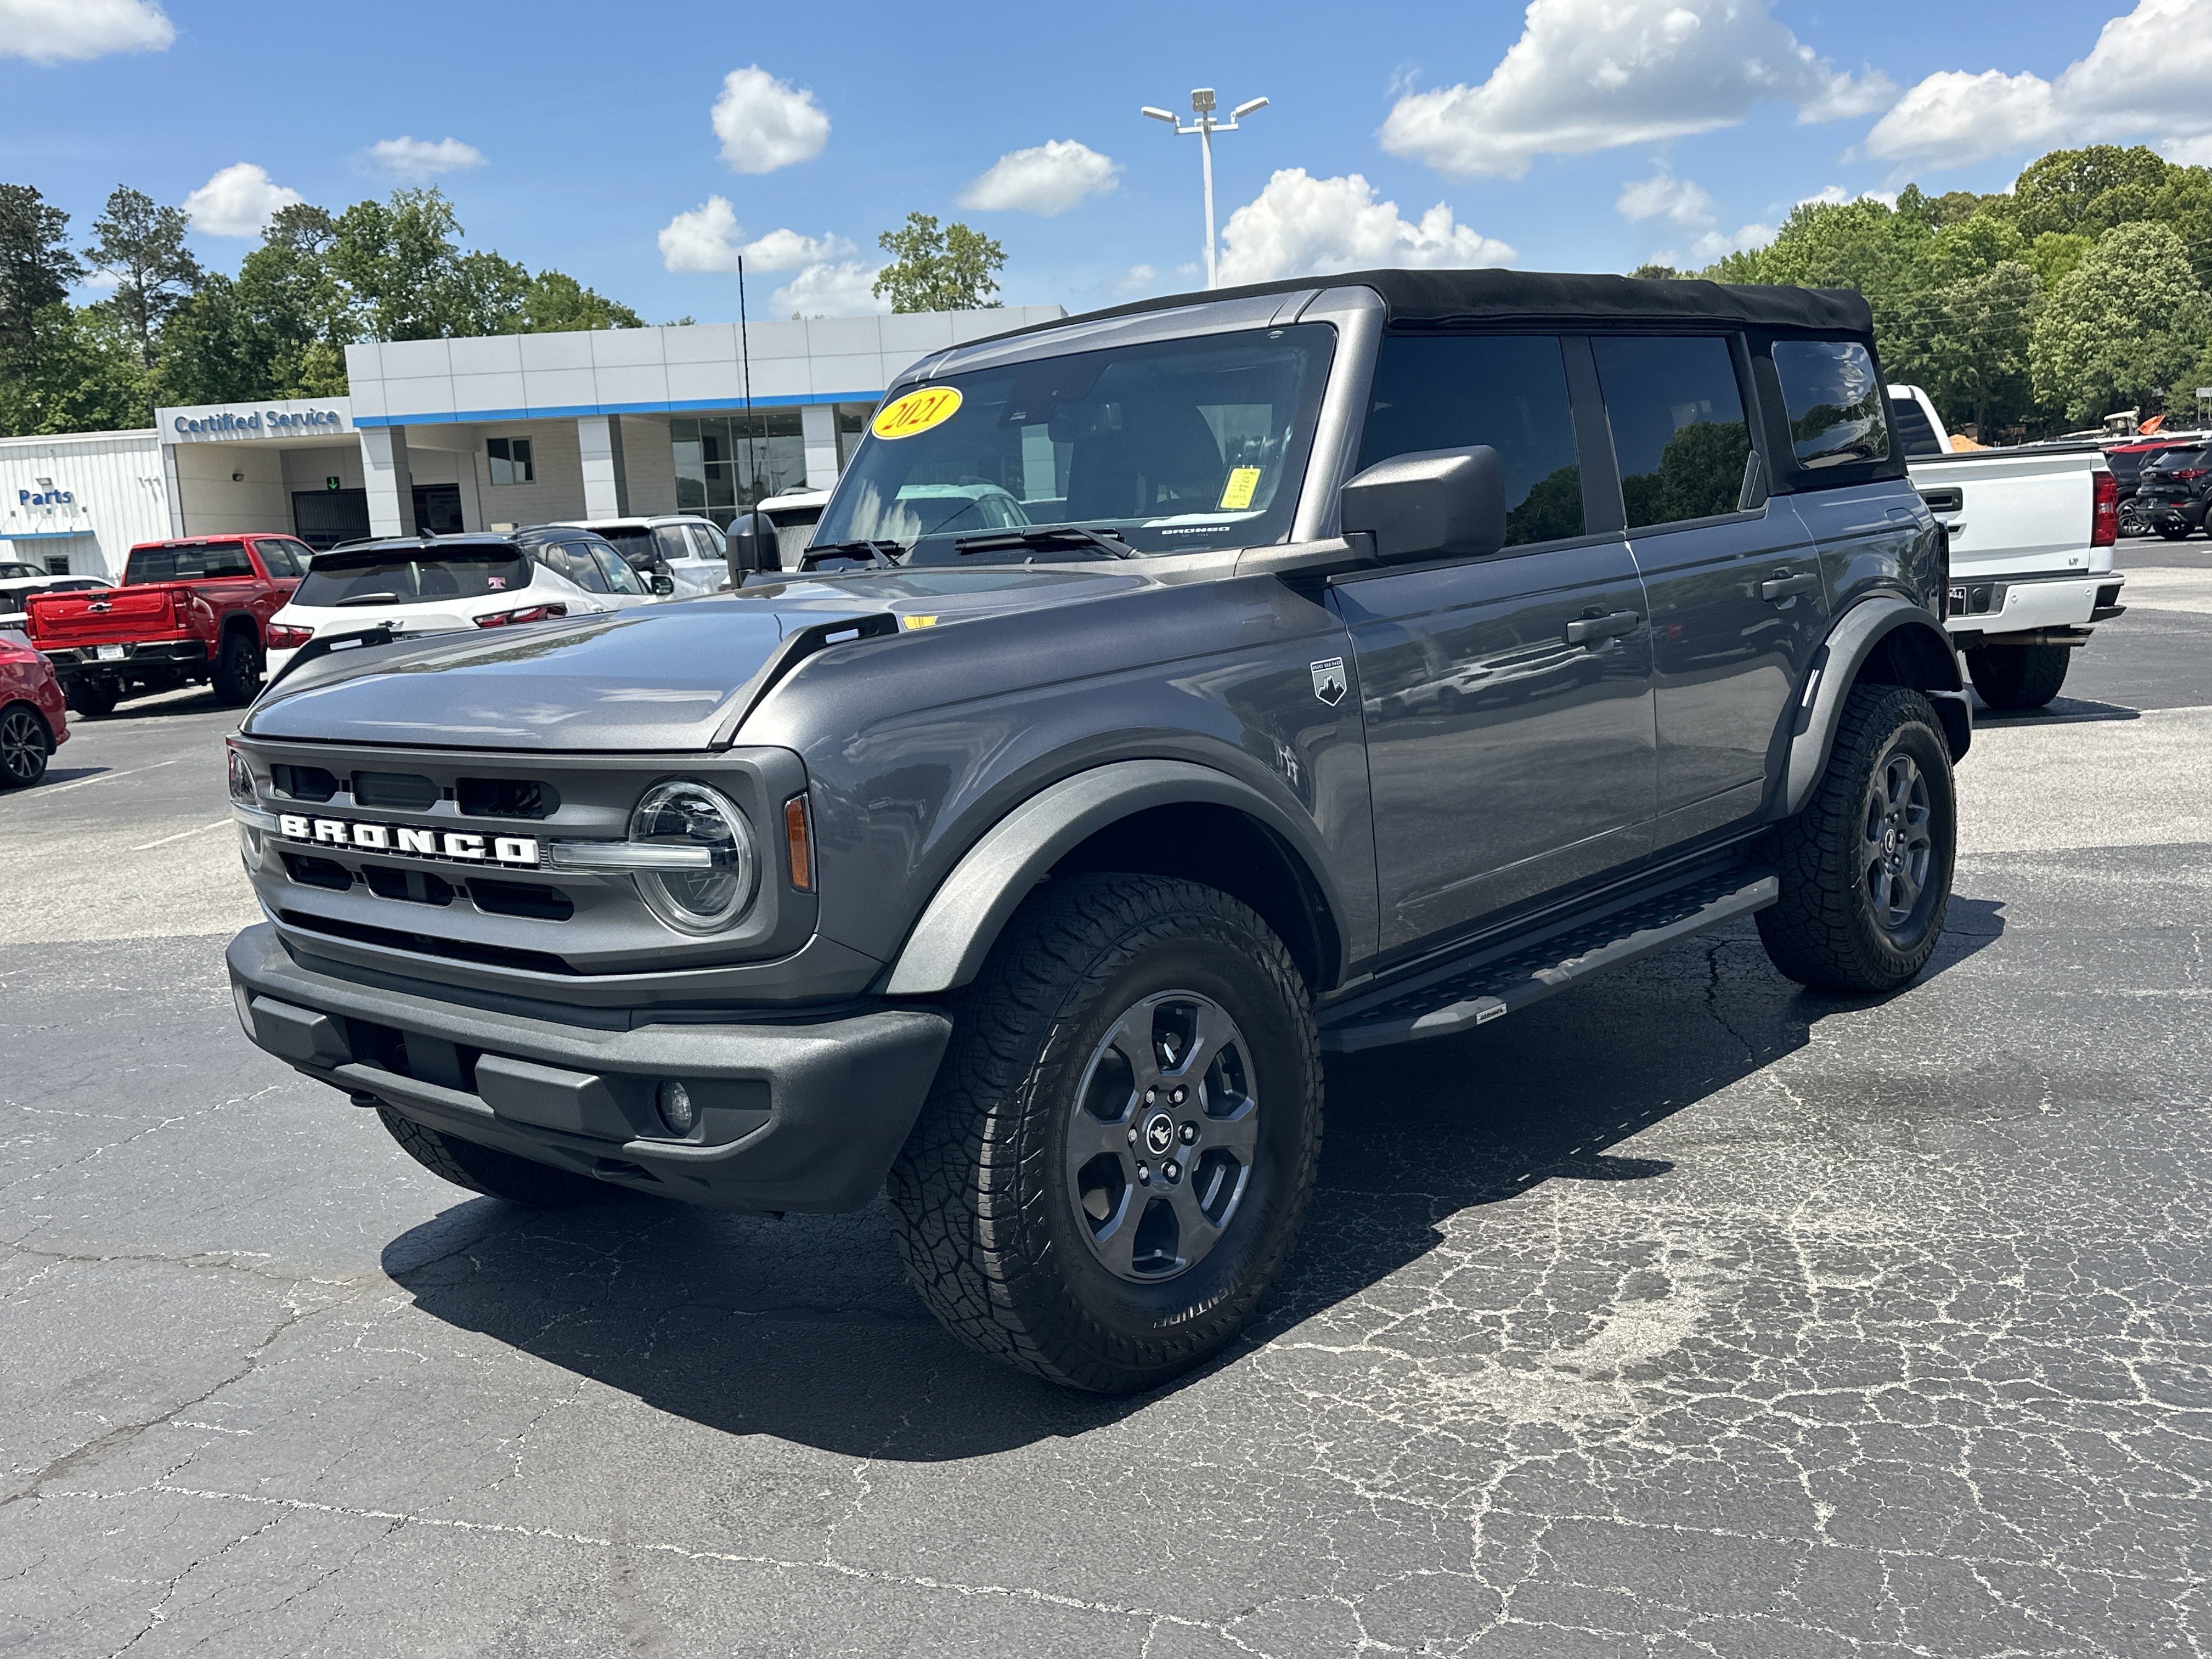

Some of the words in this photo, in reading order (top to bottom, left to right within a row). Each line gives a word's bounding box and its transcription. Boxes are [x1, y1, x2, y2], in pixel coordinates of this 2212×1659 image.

[174, 411, 259, 432] Certified
[266, 408, 338, 427] Service
[881, 393, 951, 431] 2021
[19, 489, 71, 505] Parts
[280, 814, 539, 863] BRONCO
